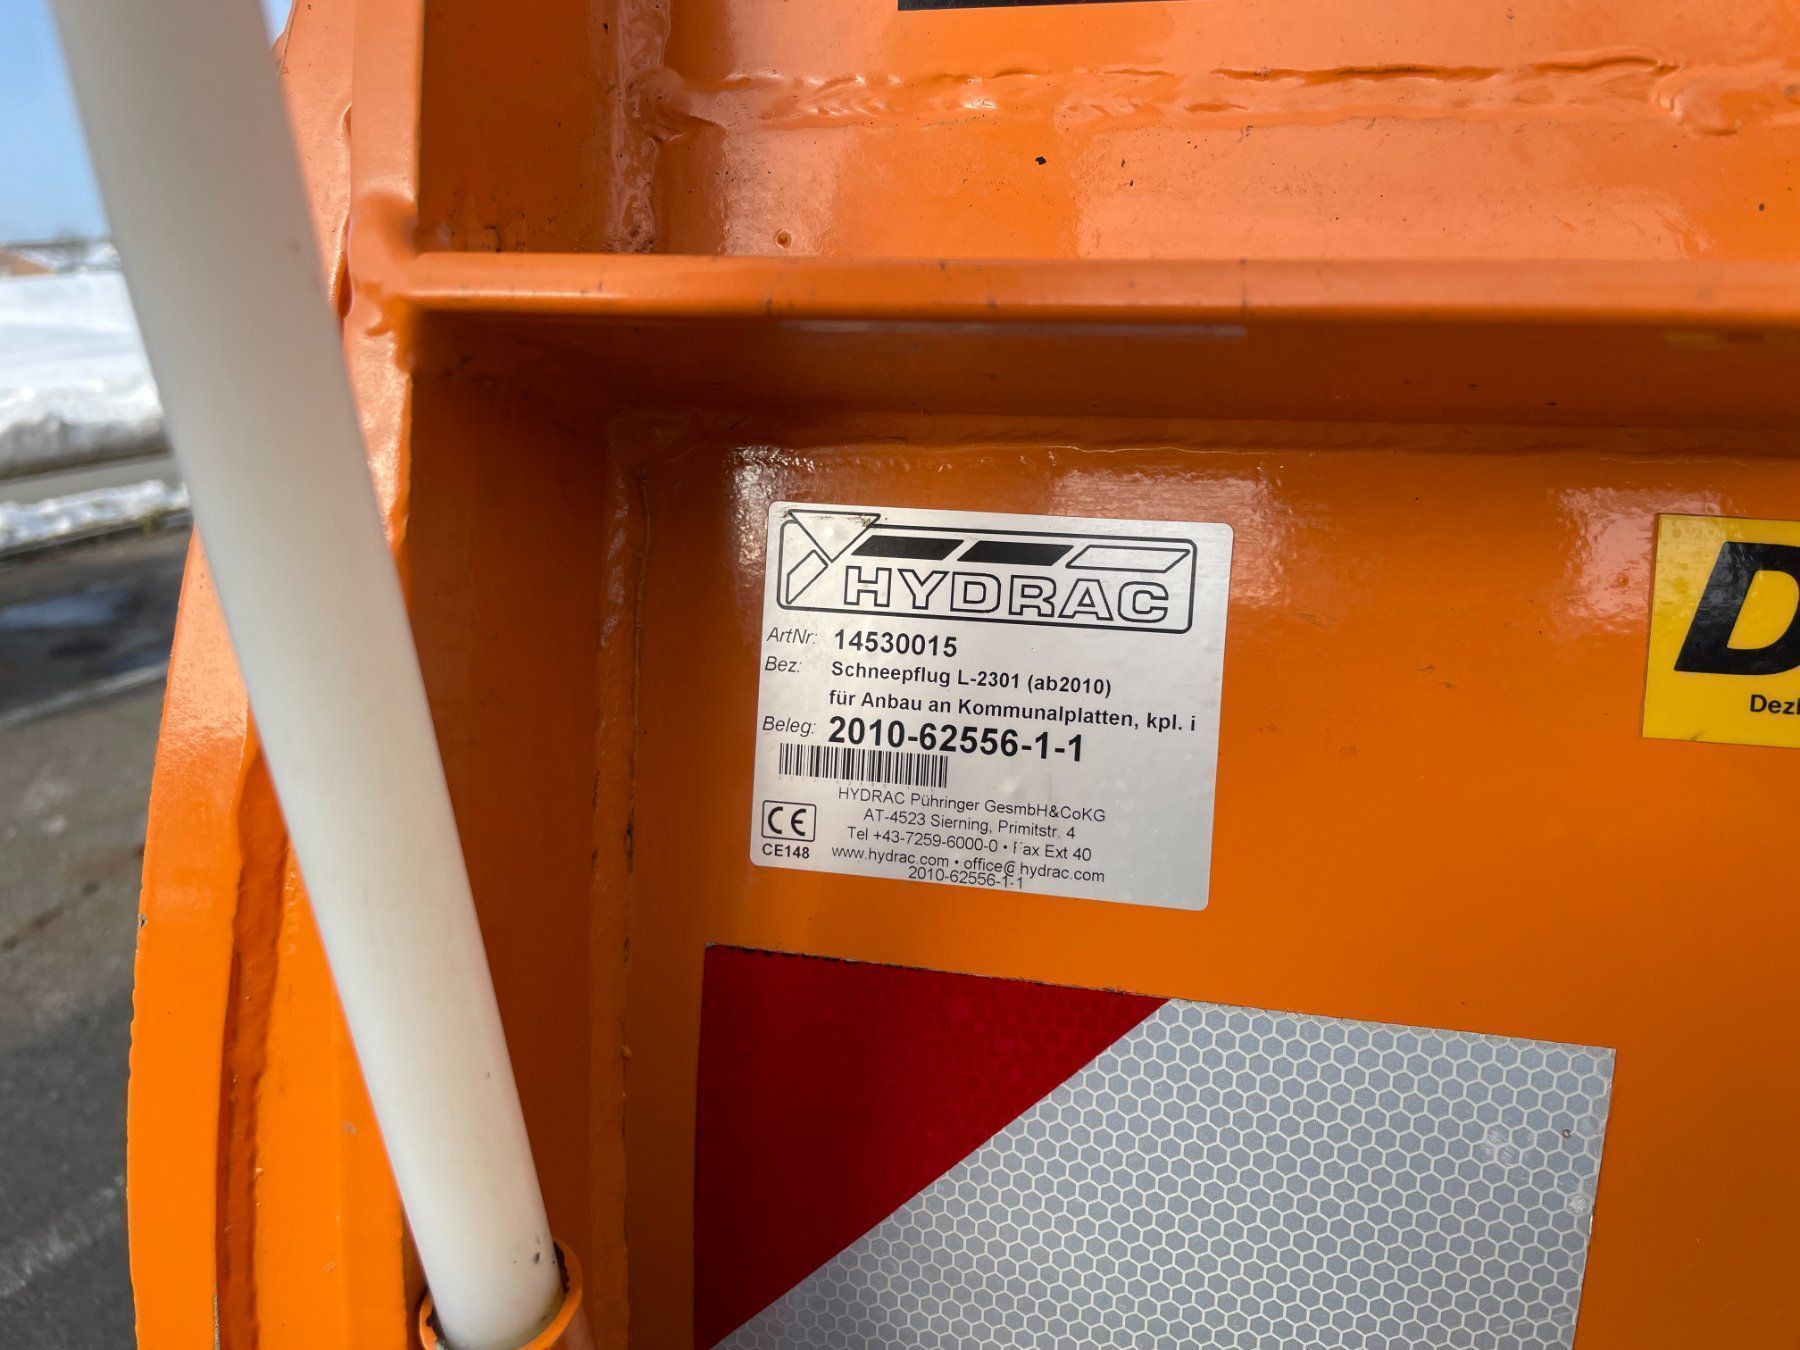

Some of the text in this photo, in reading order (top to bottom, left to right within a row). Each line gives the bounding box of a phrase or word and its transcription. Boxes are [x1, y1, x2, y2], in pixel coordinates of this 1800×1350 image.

[843, 565, 1169, 623] HYDRAC
[766, 626, 958, 658] ArtNr: 14530015
[764, 655, 1112, 699] Bez: Schneepflug L-2301 (ab2010)
[829, 689, 1196, 733] für Anbau an Kommunalplatten, kpl. i
[762, 715, 1083, 763] Beleg: 2010-62556-1-1
[838, 786, 1106, 823] HYDRAC Pühringer GesmbH&CoKG
[863, 808, 1076, 840] AT-4523 Sierning, Primitstr. 4
[762, 843, 810, 860] CE148
[847, 826, 869, 841] Tel
[873, 830, 998, 853] +43-7259-6000-0
[1045, 844, 1068, 860] Ext
[1072, 847, 1092, 862] 40
[831, 846, 1105, 883] www.hydrac.com office@hydrac.com
[908, 866, 1023, 890] 2010-62556-1-1
